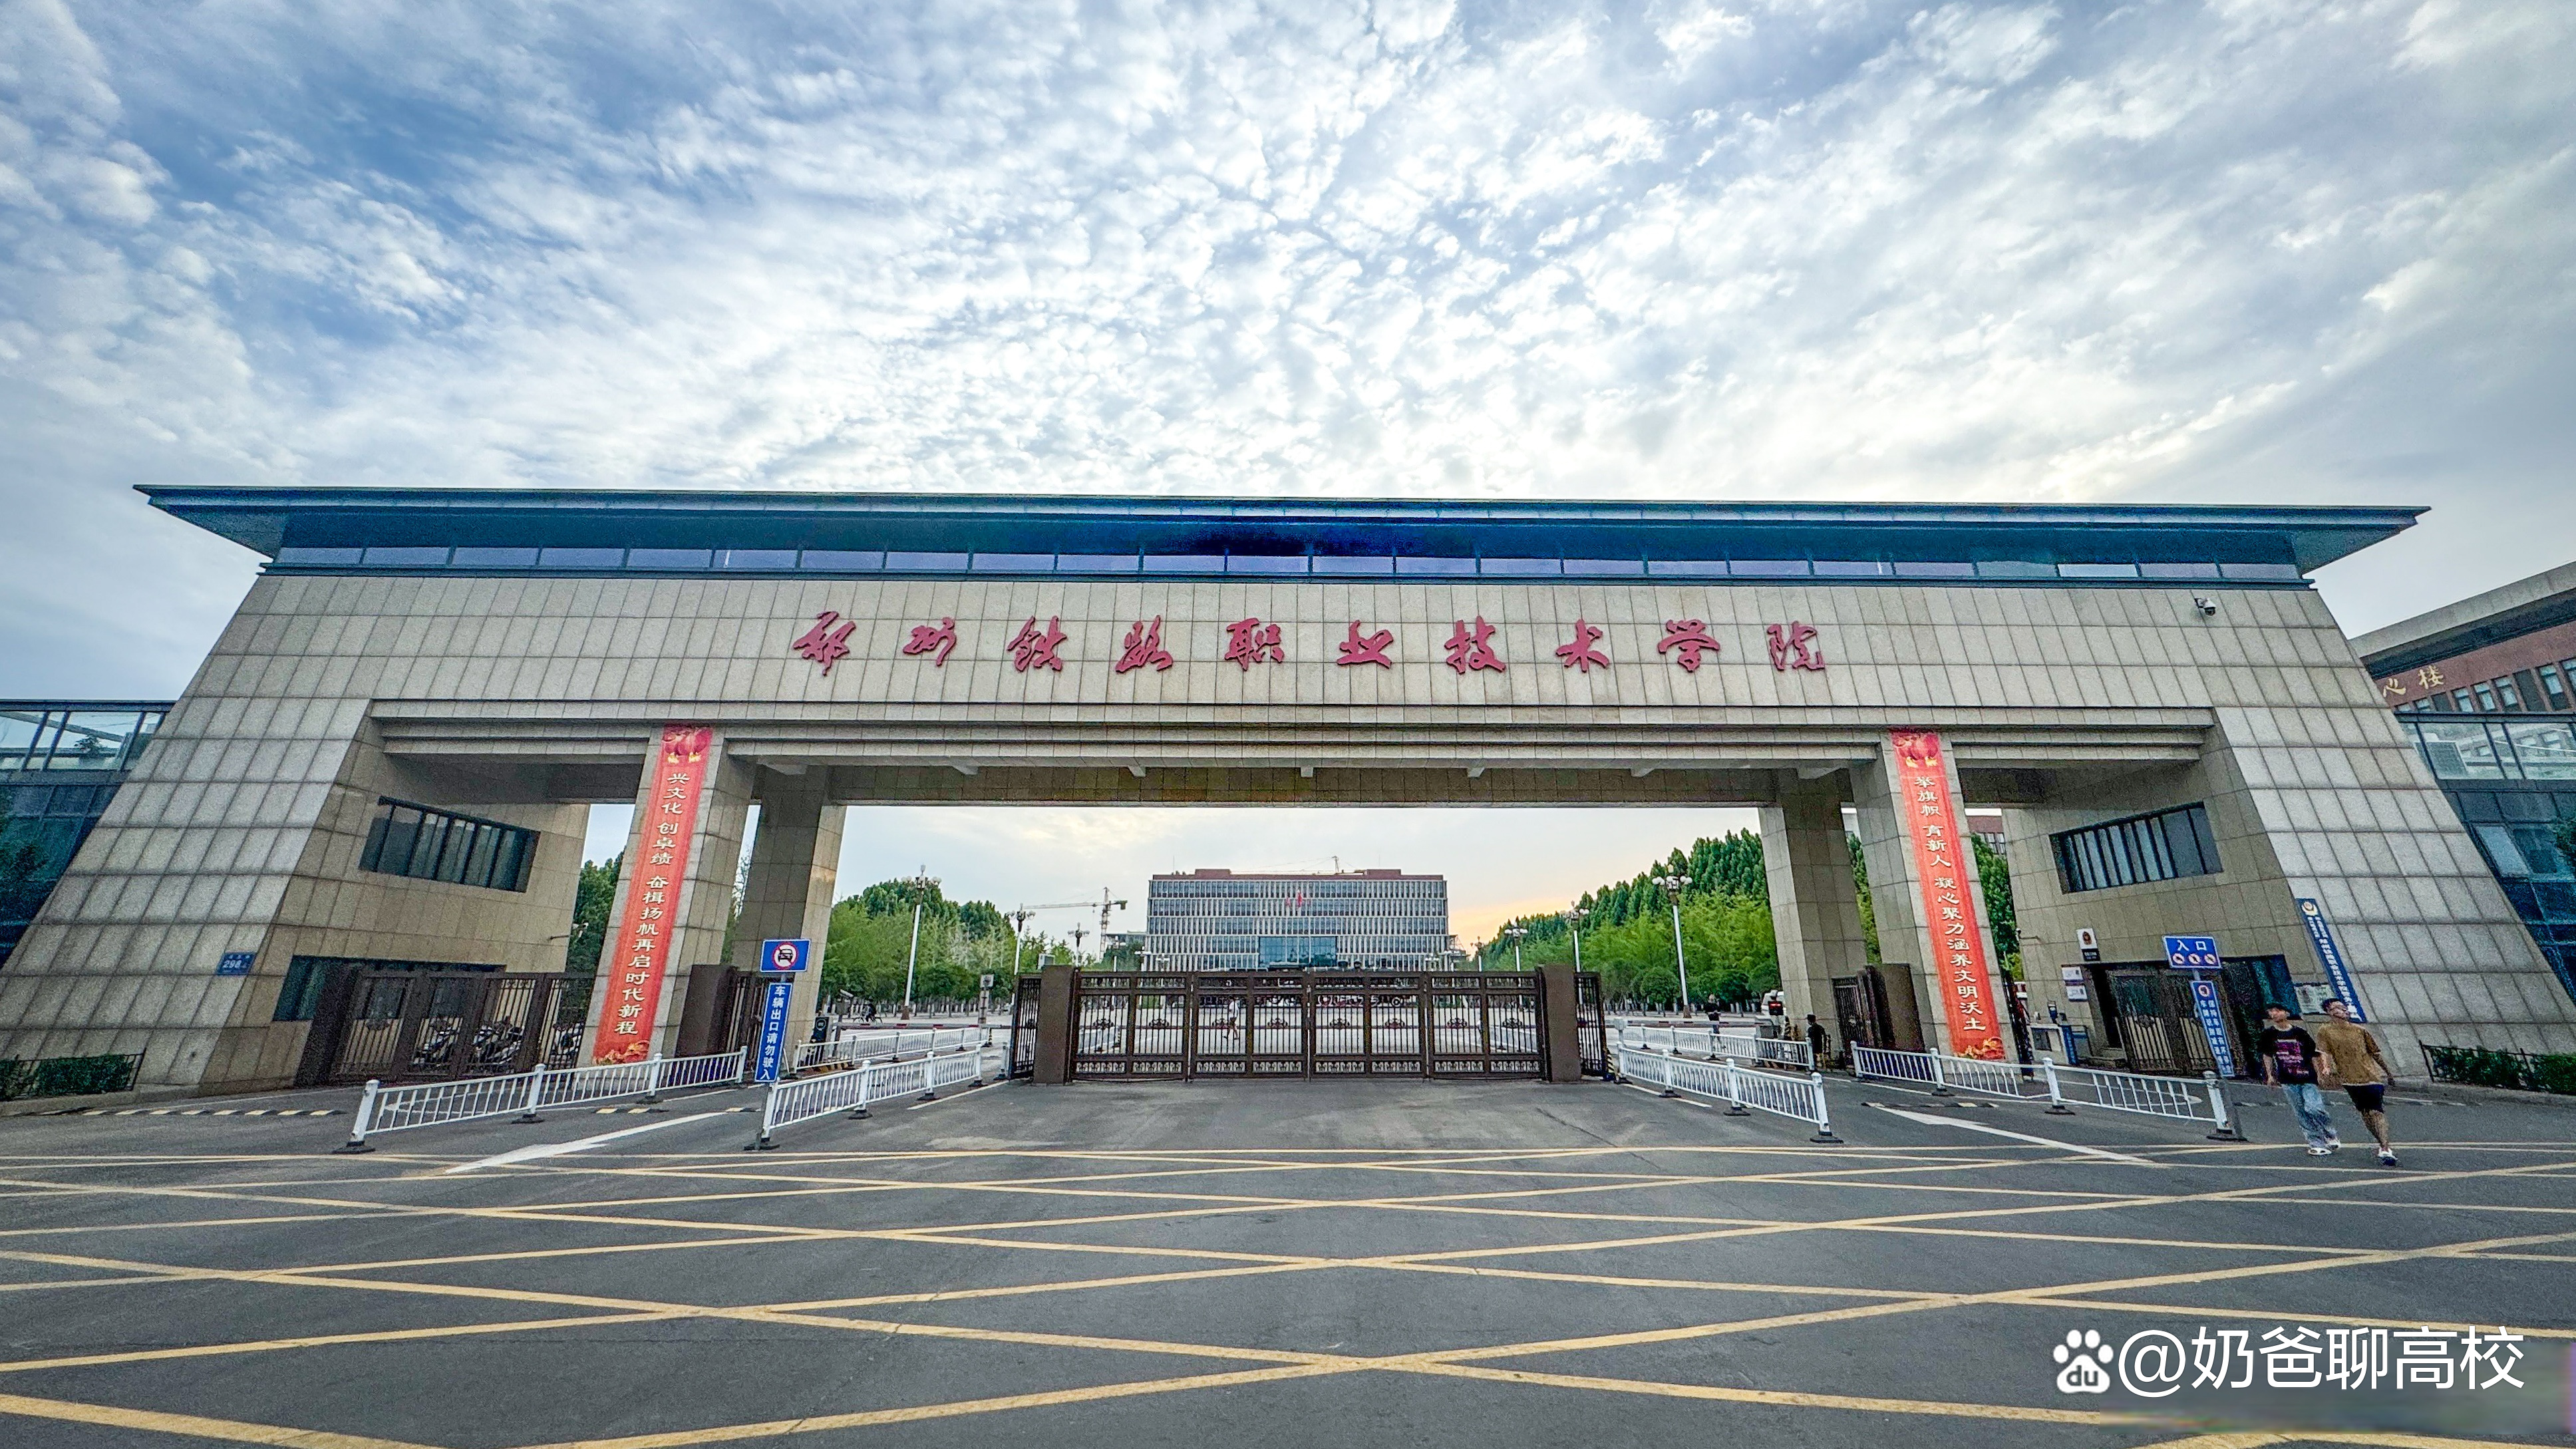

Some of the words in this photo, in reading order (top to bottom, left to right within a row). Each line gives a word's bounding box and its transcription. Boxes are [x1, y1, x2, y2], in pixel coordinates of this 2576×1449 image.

[661, 773, 691, 814] 兴文化
[1914, 776, 1942, 816] 举旗帜
[649, 822, 679, 865] 创卓绩
[1923, 825, 1951, 866] 育新人
[614, 875, 669, 1035] 奋楫扬帆再启时代新程
[1934, 877, 1987, 1031] 凝心聚力涵养文明沃土
[2177, 939, 2207, 951] 入口
[762, 986, 786, 1080] 车辆出口请勿驶入
